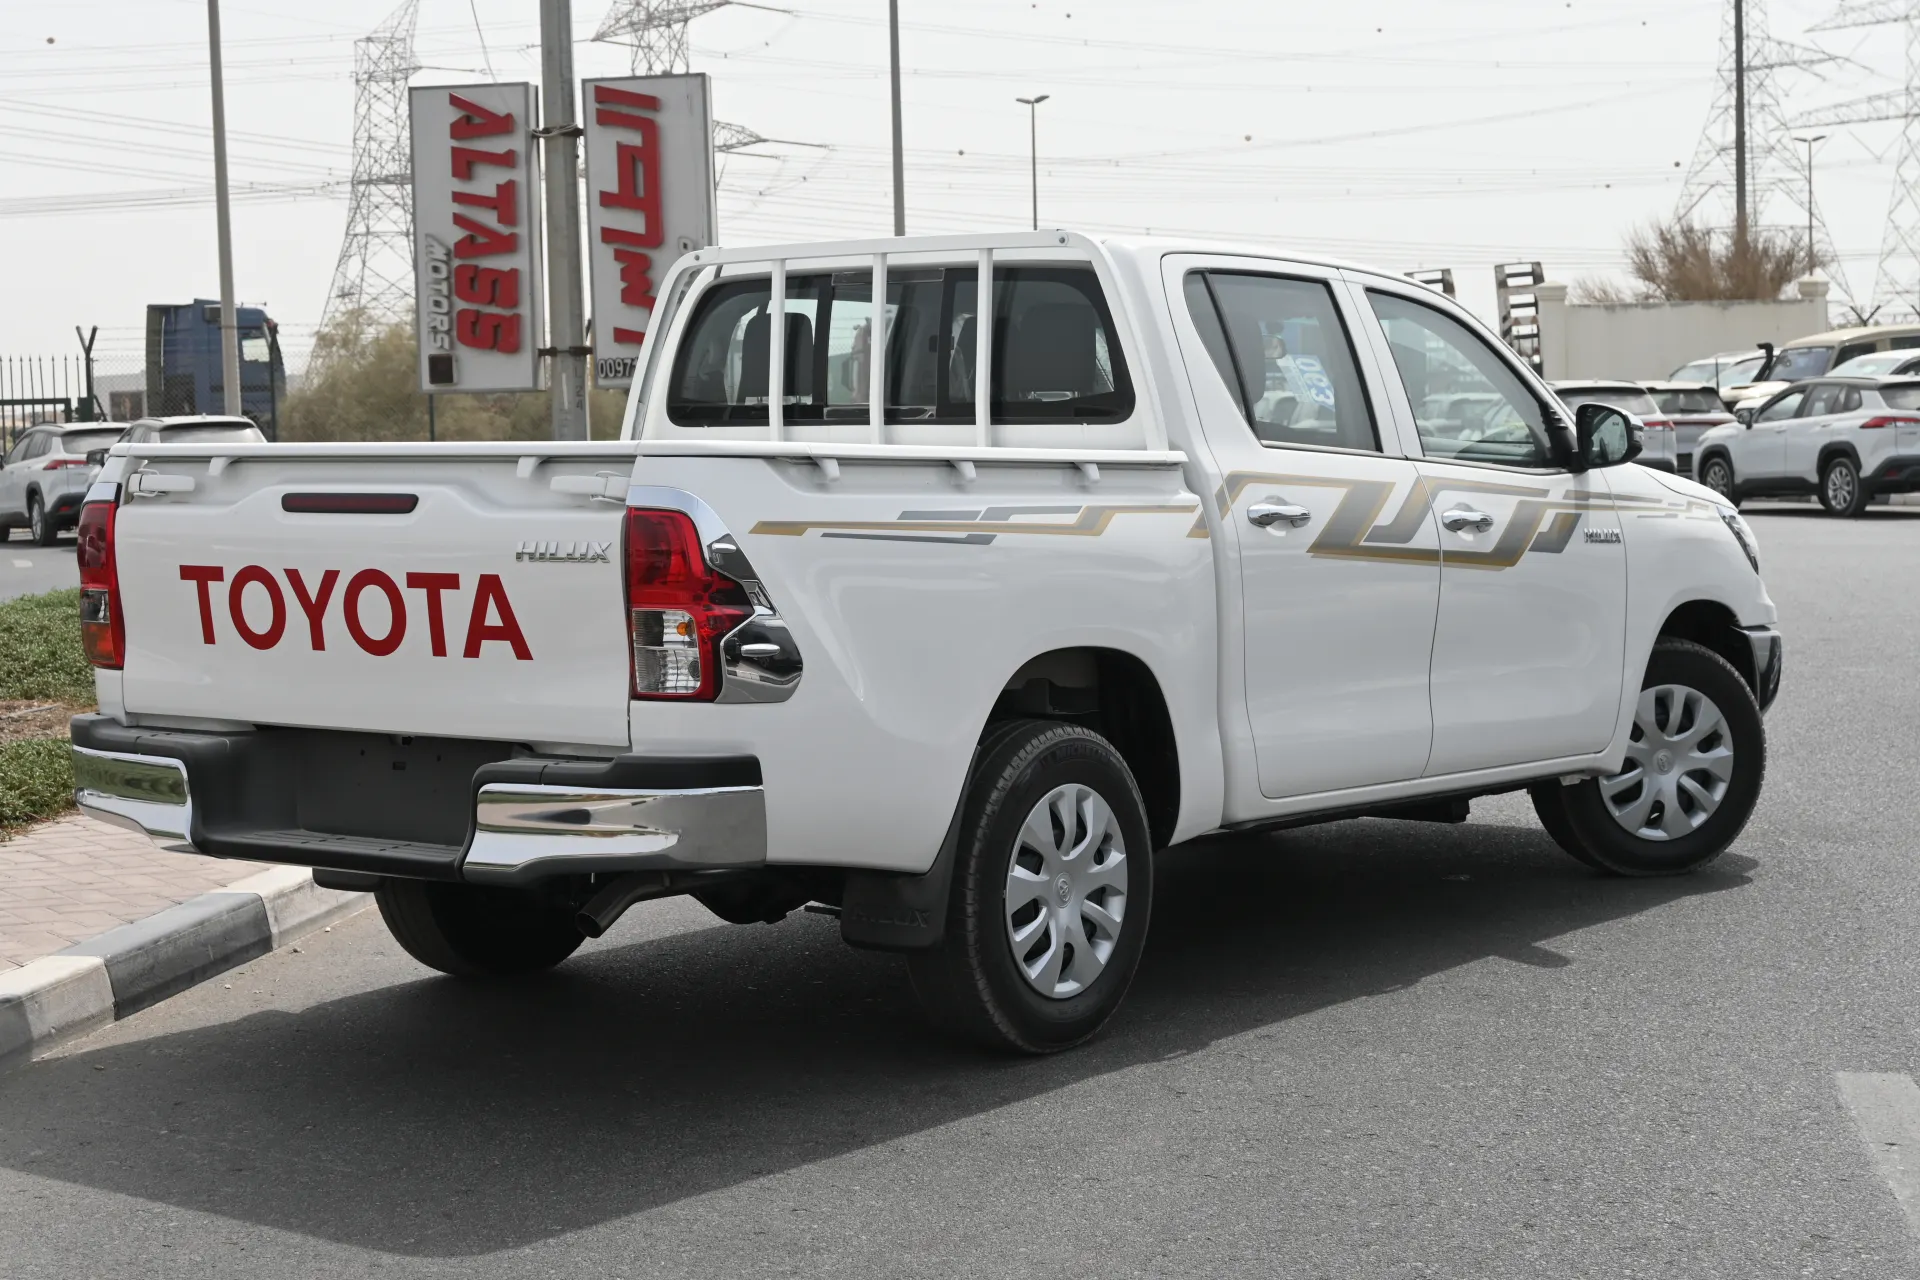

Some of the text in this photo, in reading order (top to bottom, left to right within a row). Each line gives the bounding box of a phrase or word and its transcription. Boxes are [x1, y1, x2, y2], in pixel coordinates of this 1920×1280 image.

[449, 92, 521, 354] ALTASS
[426, 234, 450, 350] MOTORS
[515, 541, 612, 563] HILUX
[179, 564, 533, 660] TOYOTA
